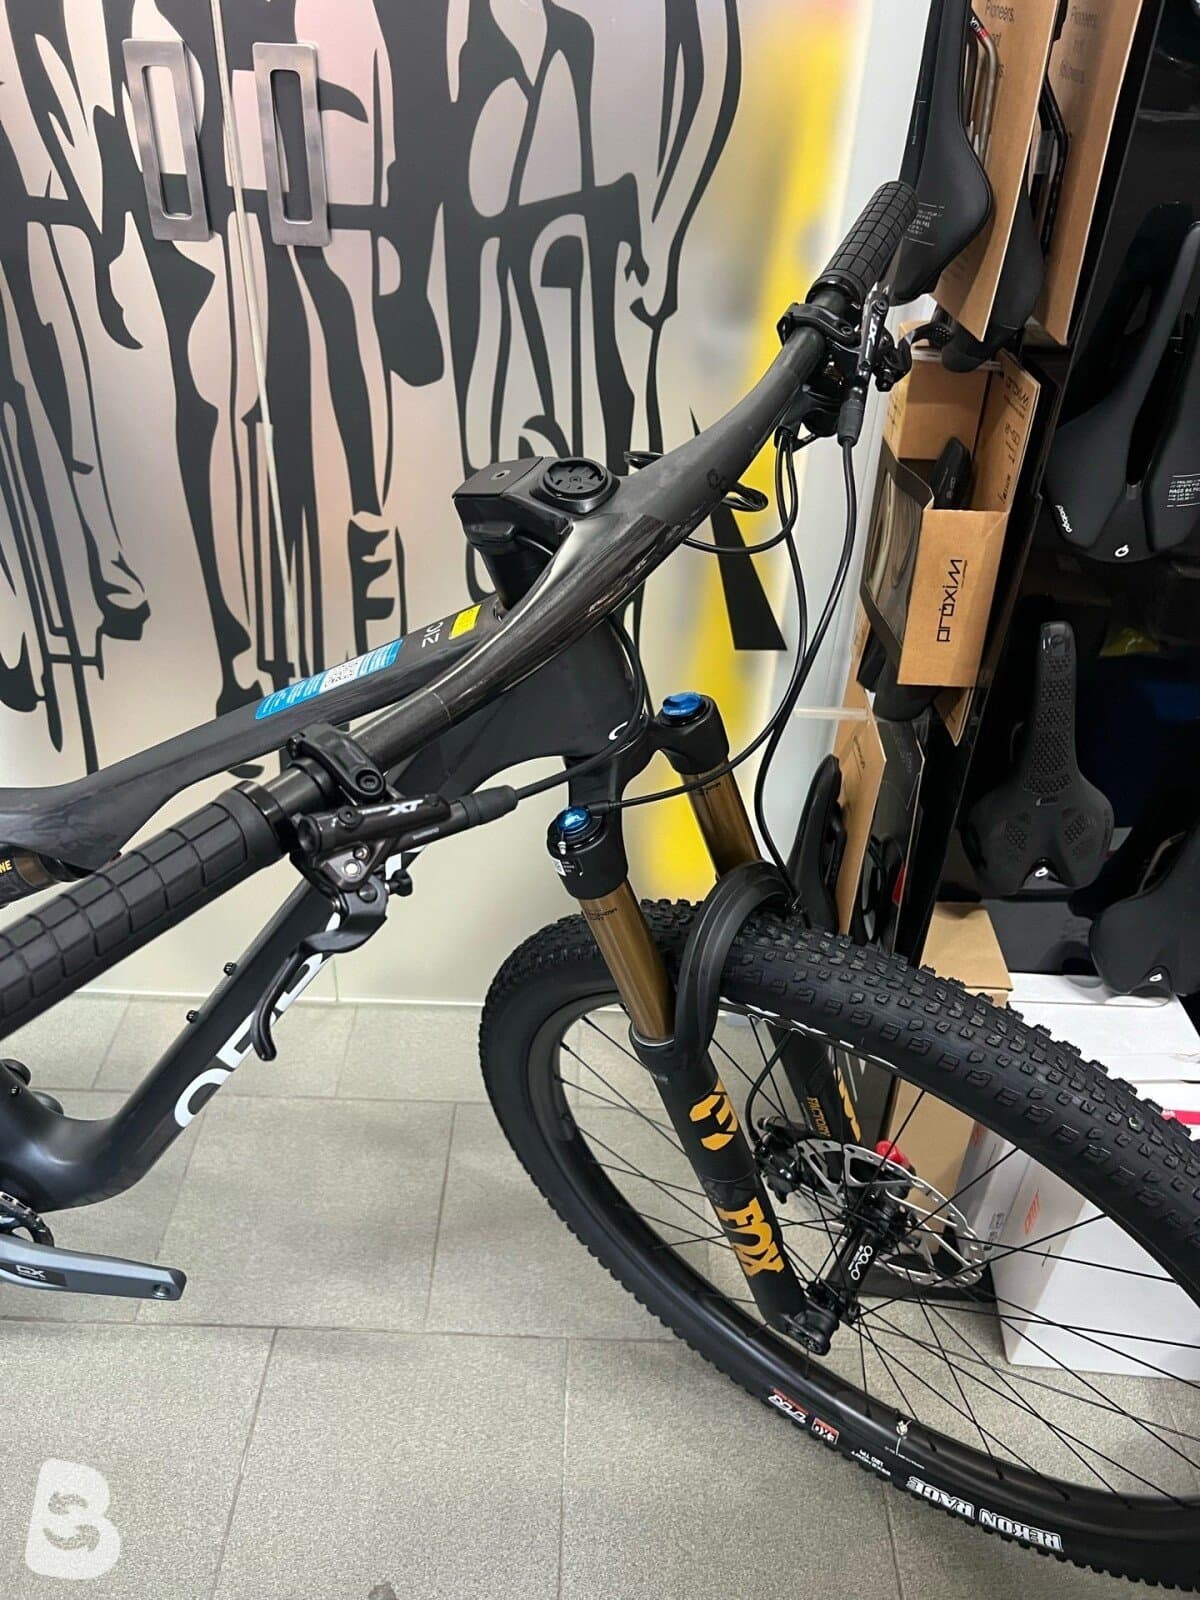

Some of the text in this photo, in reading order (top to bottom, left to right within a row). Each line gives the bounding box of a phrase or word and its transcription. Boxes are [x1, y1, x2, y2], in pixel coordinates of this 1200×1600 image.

[715, 1197, 786, 1277] FOX
[905, 1475, 1064, 1553] REKON RACE
